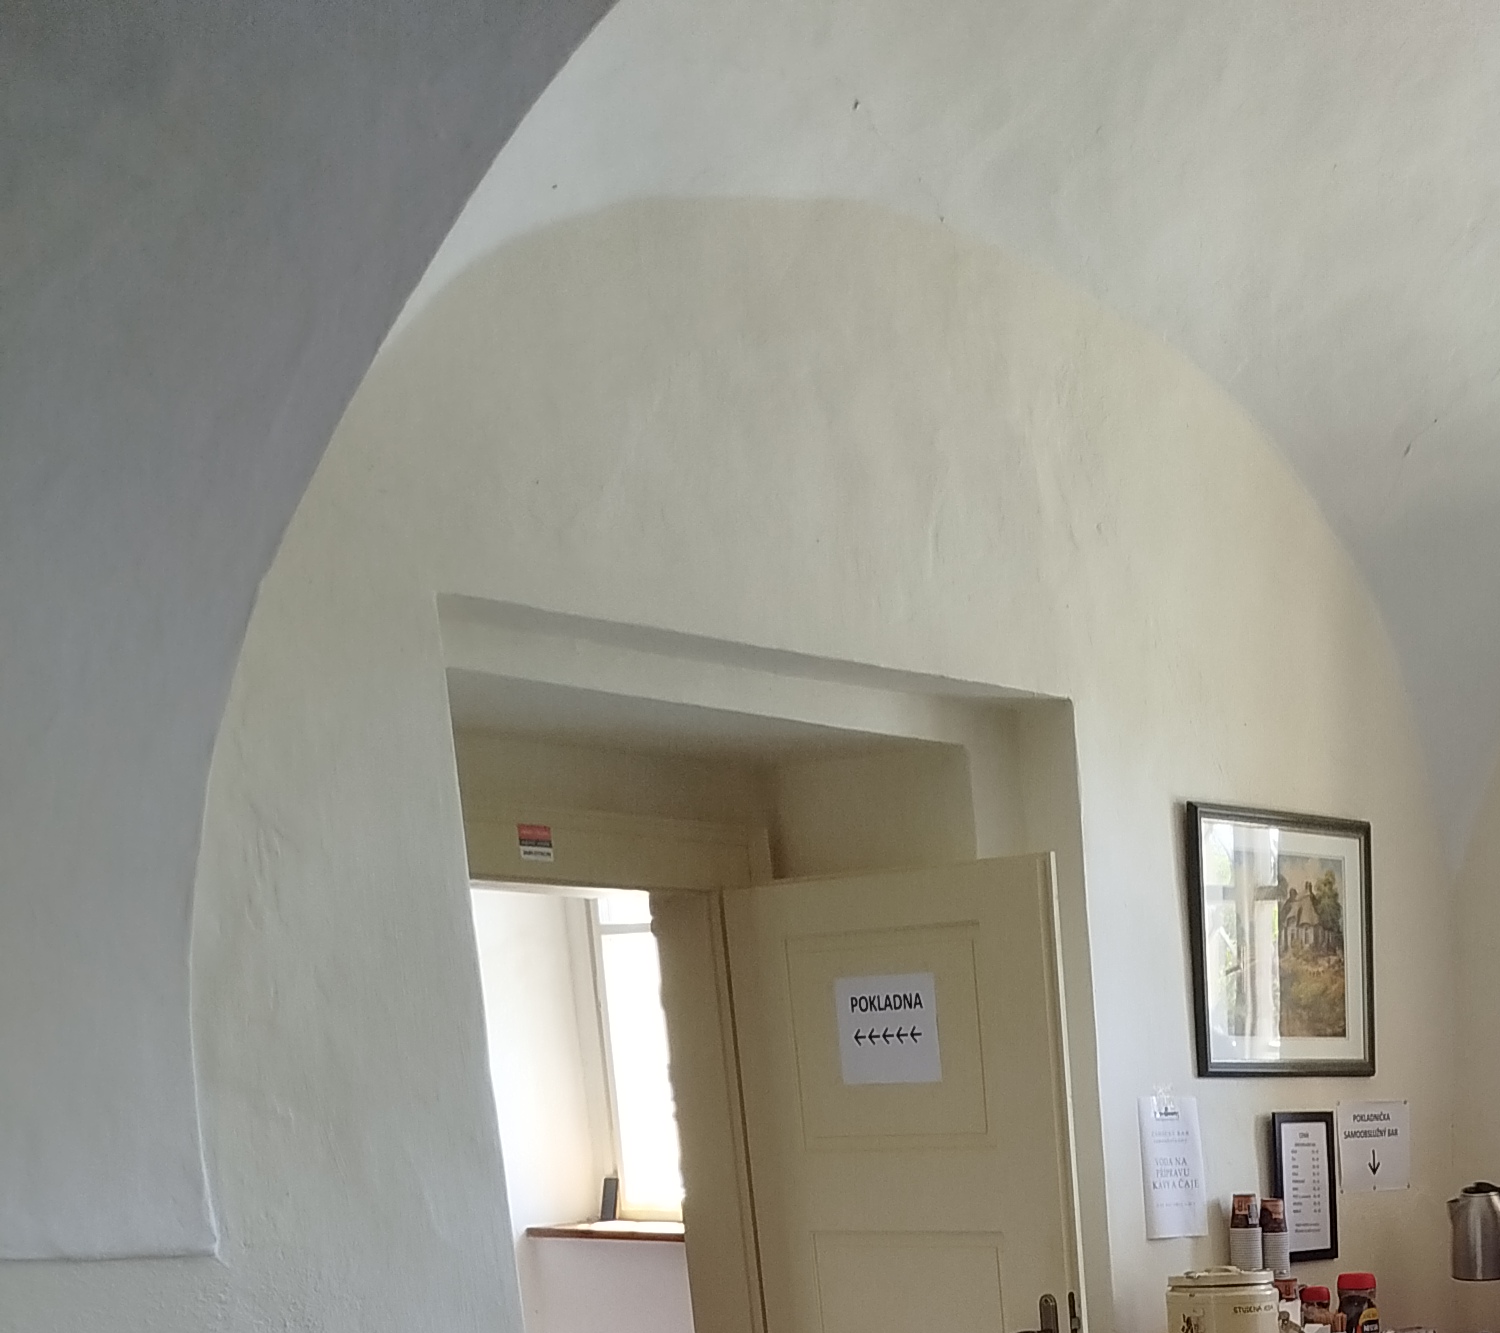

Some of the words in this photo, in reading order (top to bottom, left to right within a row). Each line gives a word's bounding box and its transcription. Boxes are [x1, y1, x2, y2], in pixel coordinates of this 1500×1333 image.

[850, 992, 923, 1013] POKLADNA
[1387, 1128, 1398, 1137] BAR
[1175, 1156, 1188, 1166] NA
